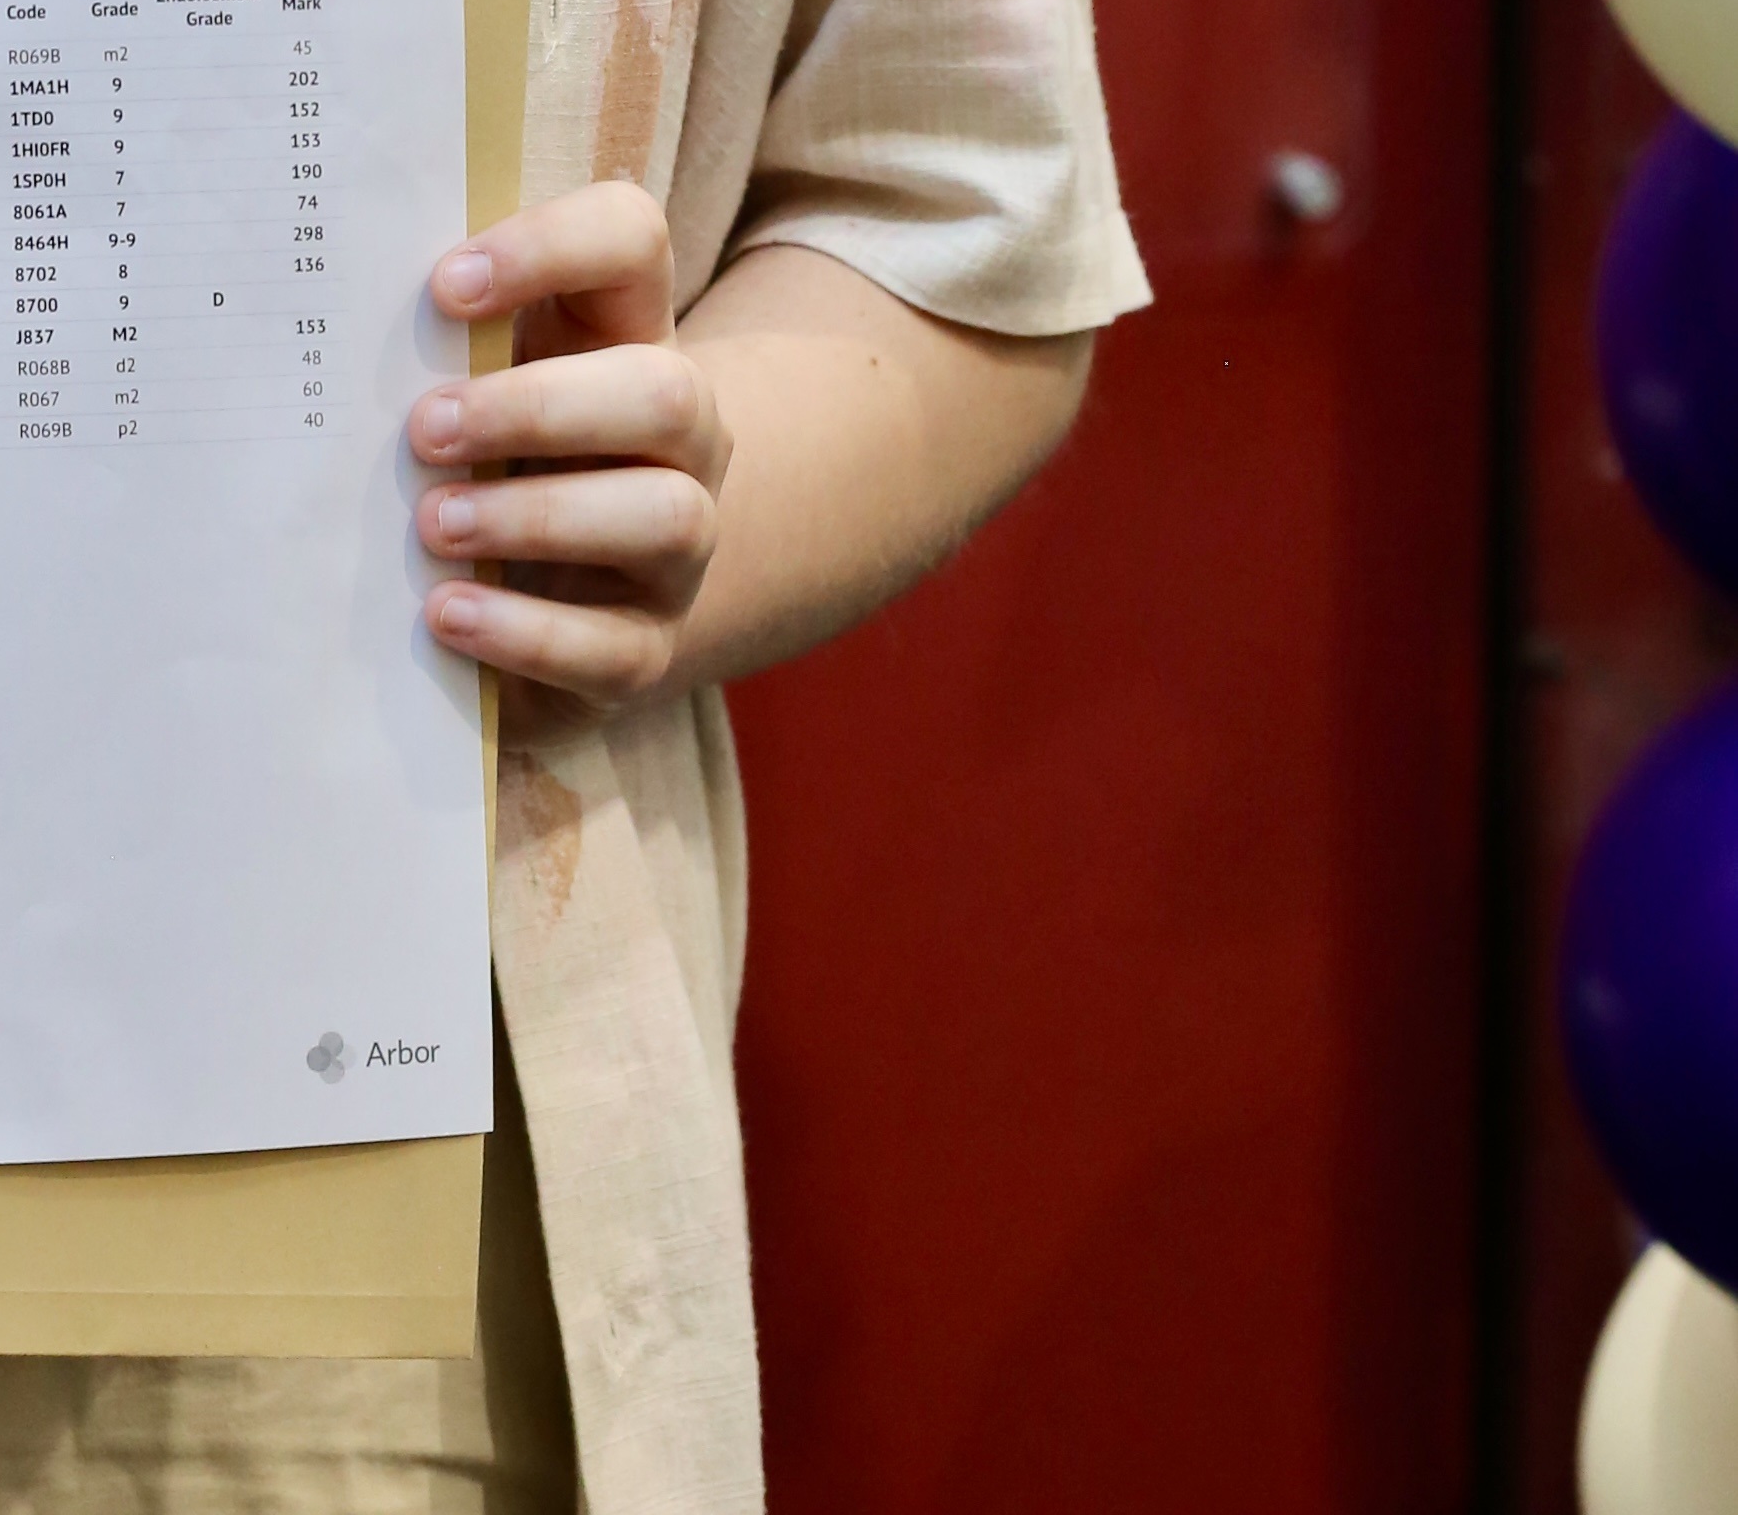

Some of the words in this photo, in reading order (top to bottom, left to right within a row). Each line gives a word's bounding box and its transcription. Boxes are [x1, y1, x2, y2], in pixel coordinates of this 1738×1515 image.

[7, 4, 46, 20] Code
[91, 1, 138, 17] Grade
[186, 11, 233, 26] Grade
[10, 79, 69, 96] 1MA1H
[112, 77, 122, 93] 9
[289, 71, 319, 86] 202
[113, 108, 123, 123] 9
[290, 101, 319, 117] 152
[114, 139, 124, 154] 9
[291, 133, 320, 148] 153
[115, 170, 125, 186] 7
[292, 164, 322, 179] 190
[14, 204, 67, 220] 8061A
[117, 202, 126, 217] 7
[298, 195, 318, 210] 74
[14, 235, 68, 251] 8464H
[109, 233, 136, 248] 9-9
[294, 226, 323, 241] 298
[15, 266, 56, 282] 8702
[119, 264, 128, 279] 8
[294, 256, 324, 273] 136
[16, 297, 58, 313] 8700
[119, 295, 129, 310] 9
[213, 292, 224, 307] D
[16, 329, 54, 345] J837
[113, 326, 137, 341] M2
[296, 319, 326, 334] 153
[18, 360, 70, 376] R068B
[116, 357, 135, 373] d2
[302, 350, 321, 365] 48
[366, 1039, 440, 1067] Arbor
